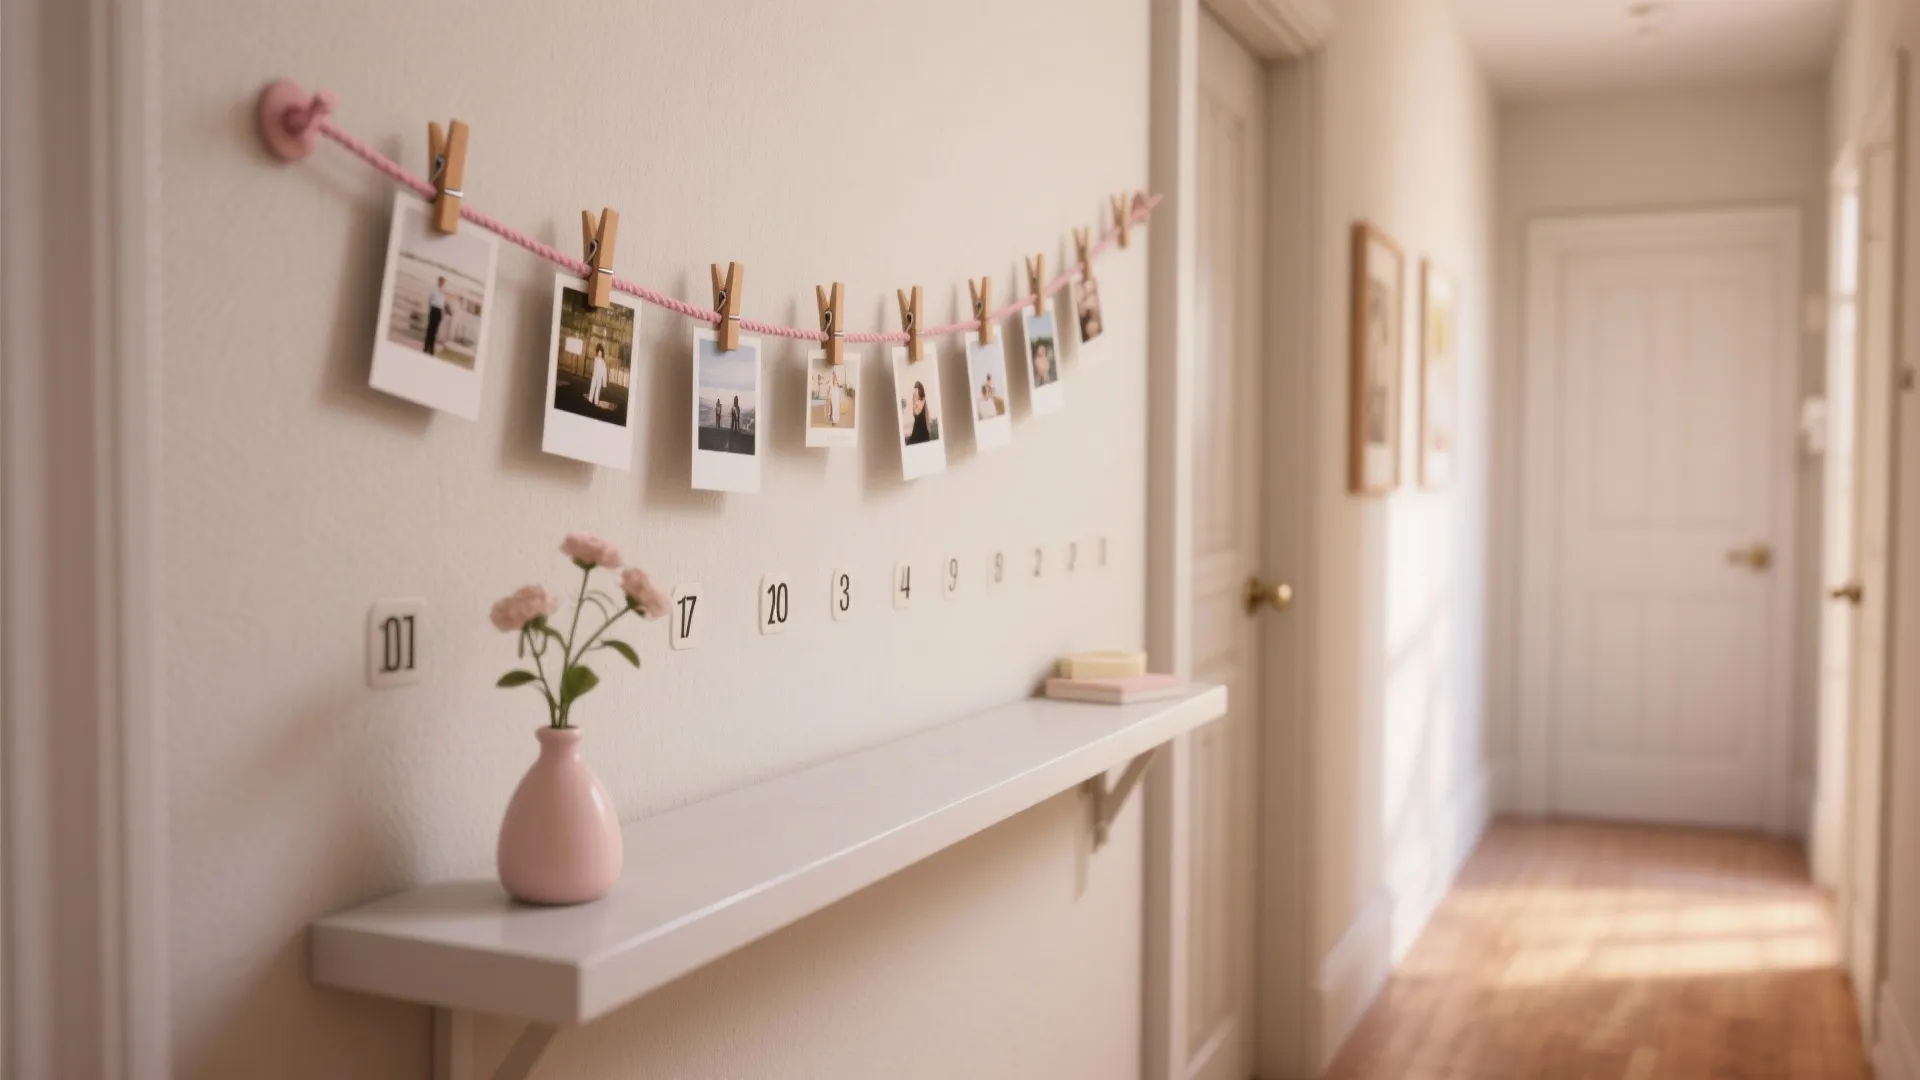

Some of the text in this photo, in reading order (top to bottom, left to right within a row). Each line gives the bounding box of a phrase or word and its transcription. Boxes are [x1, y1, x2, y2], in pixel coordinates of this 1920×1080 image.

[839, 573, 850, 611] 3
[900, 565, 910, 599] 4
[949, 558, 958, 592] 9
[677, 595, 697, 638] 17
